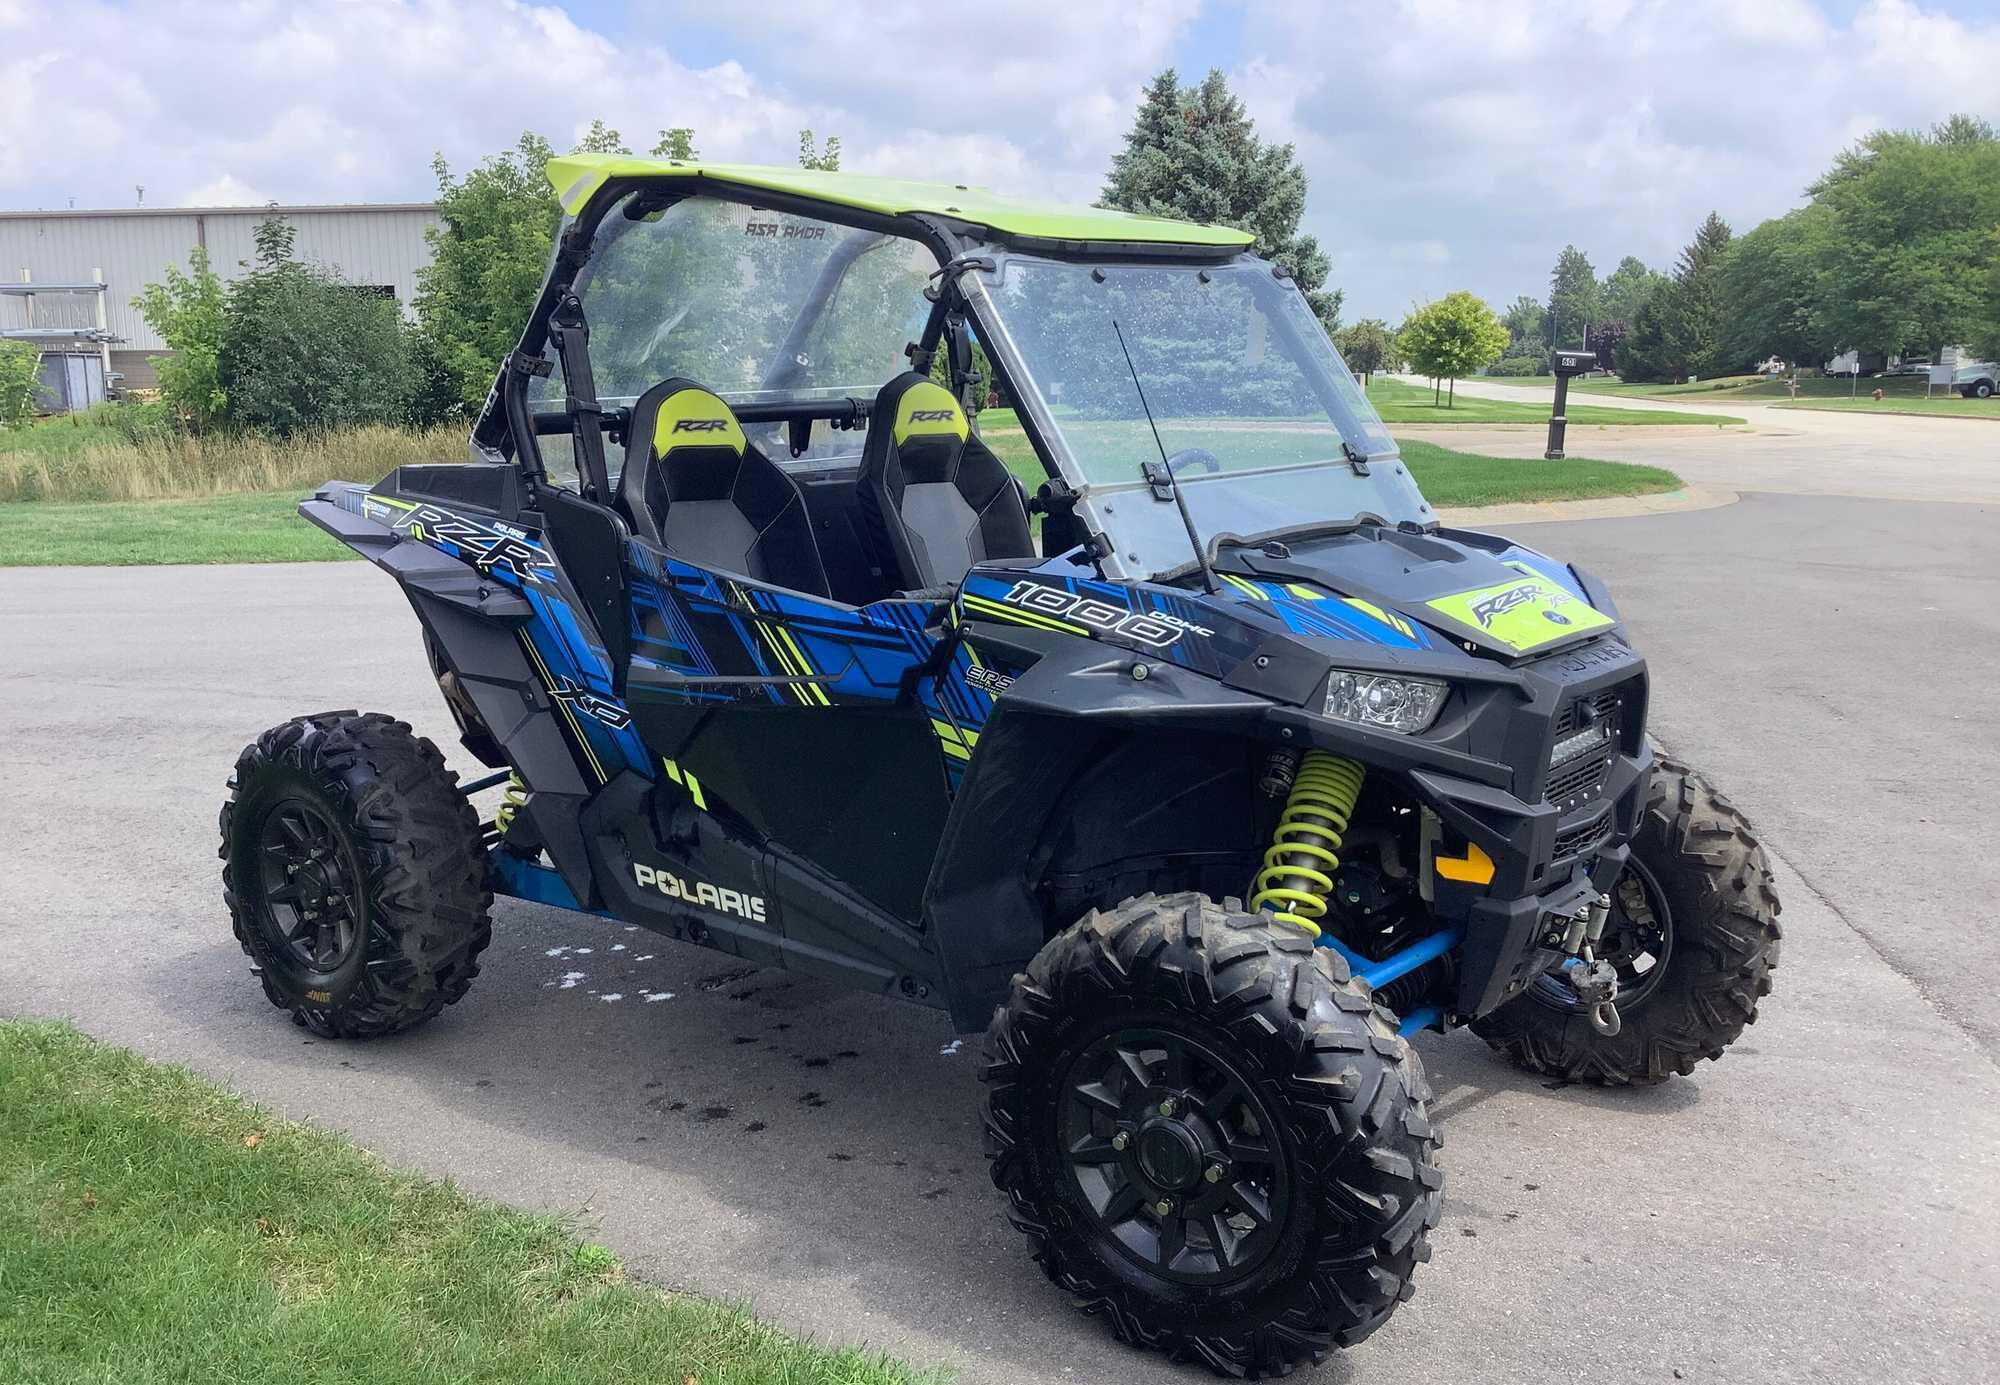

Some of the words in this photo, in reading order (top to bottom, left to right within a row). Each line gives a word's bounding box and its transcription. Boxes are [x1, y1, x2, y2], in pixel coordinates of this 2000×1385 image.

[671, 417, 729, 435] RZR
[907, 409, 955, 425] RZR
[392, 503, 556, 583] RZR
[493, 521, 528, 540] POLARIS
[1003, 580, 1184, 647] 1000
[1148, 610, 1215, 638] DOHC
[1472, 585, 1541, 629] RZR
[966, 664, 1015, 691] EPS
[633, 862, 766, 923] POLARIS
